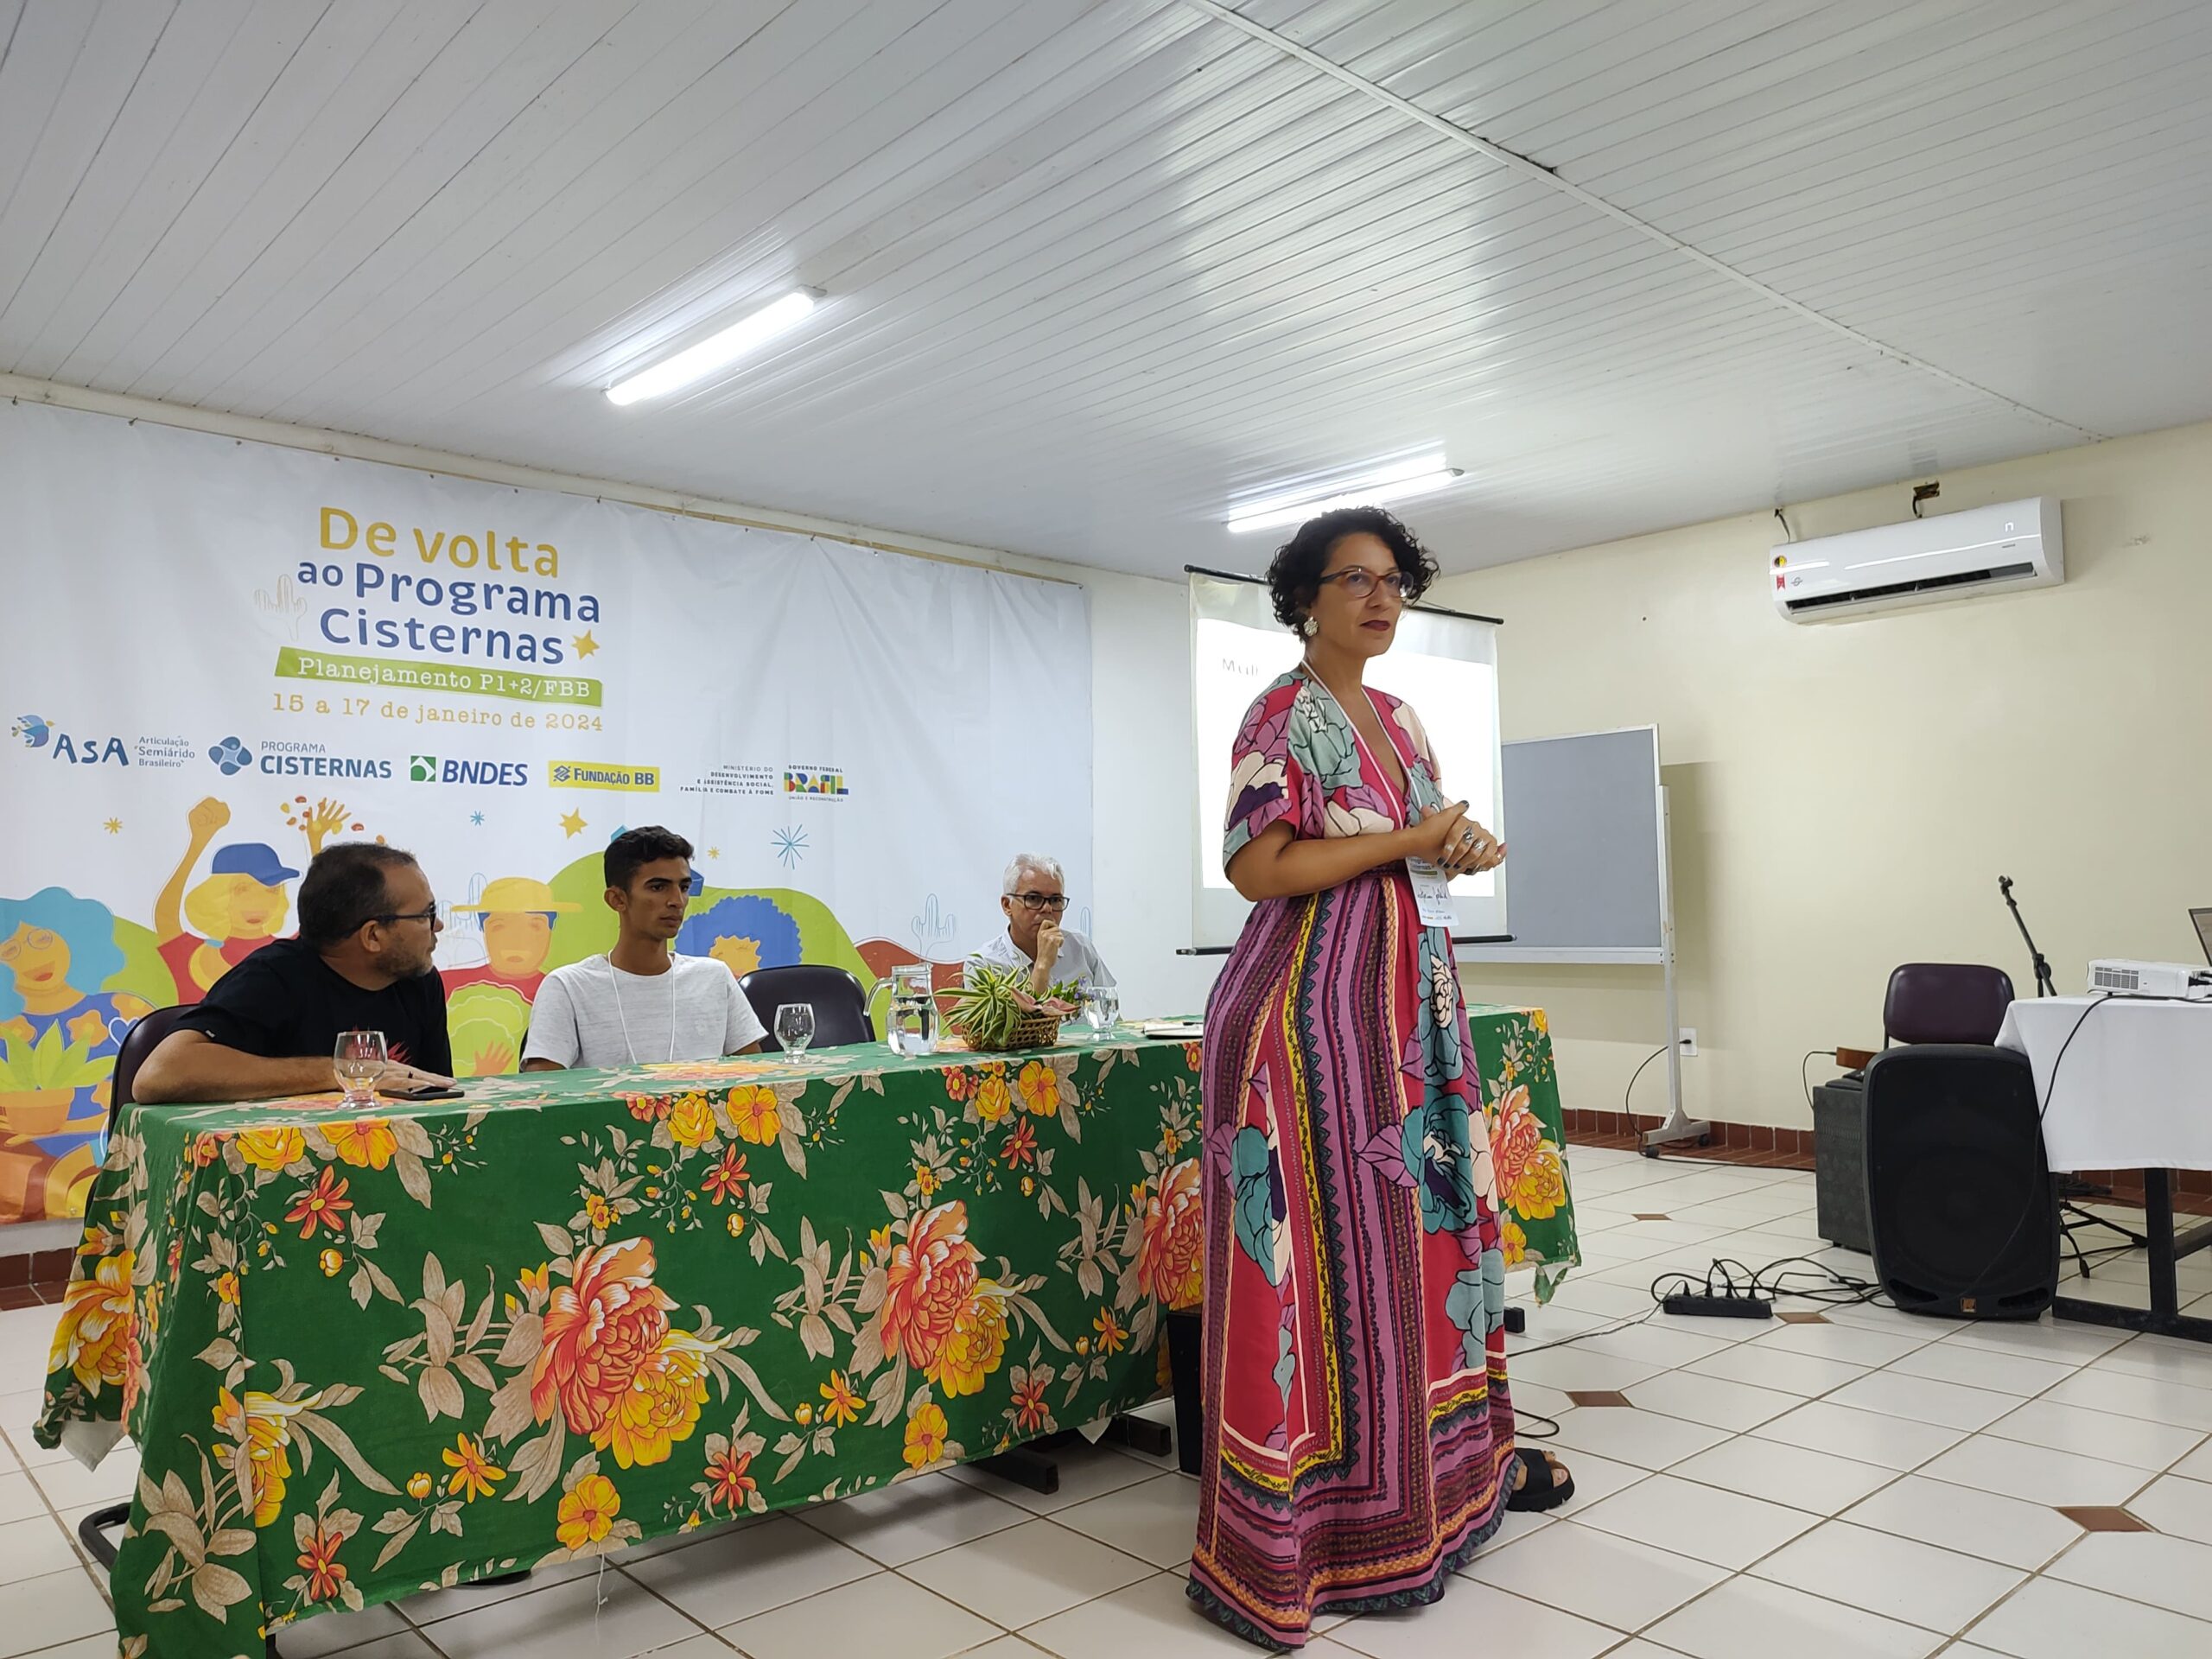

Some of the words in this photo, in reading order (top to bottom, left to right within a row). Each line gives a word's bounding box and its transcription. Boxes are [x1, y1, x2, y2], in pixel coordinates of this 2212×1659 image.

[320, 506, 397, 557] De
[413, 528, 559, 578] volta
[297, 561, 344, 588] ao
[356, 562, 601, 624] Programa
[320, 607, 565, 665] Cisternas
[297, 657, 471, 690] Planejamento
[480, 675, 590, 699] P1+2/FBB
[273, 693, 304, 713] 15
[315, 699, 331, 715] a
[342, 698, 370, 715] 17
[381, 702, 409, 719] de
[415, 705, 503, 728] janeiro
[511, 711, 536, 729] de
[545, 714, 603, 732] 2024
[138, 746, 195, 759] Semiárido
[139, 735, 189, 747] Articulação
[261, 741, 326, 753] PROGRAMA
[138, 758, 181, 768] Brasileiro
[260, 755, 392, 779] CISTERNAS
[442, 760, 529, 786] BNDES
[574, 767, 630, 785] FUNDAÇÃO
[635, 772, 655, 785] BB
[784, 772, 849, 795] BRASIL
